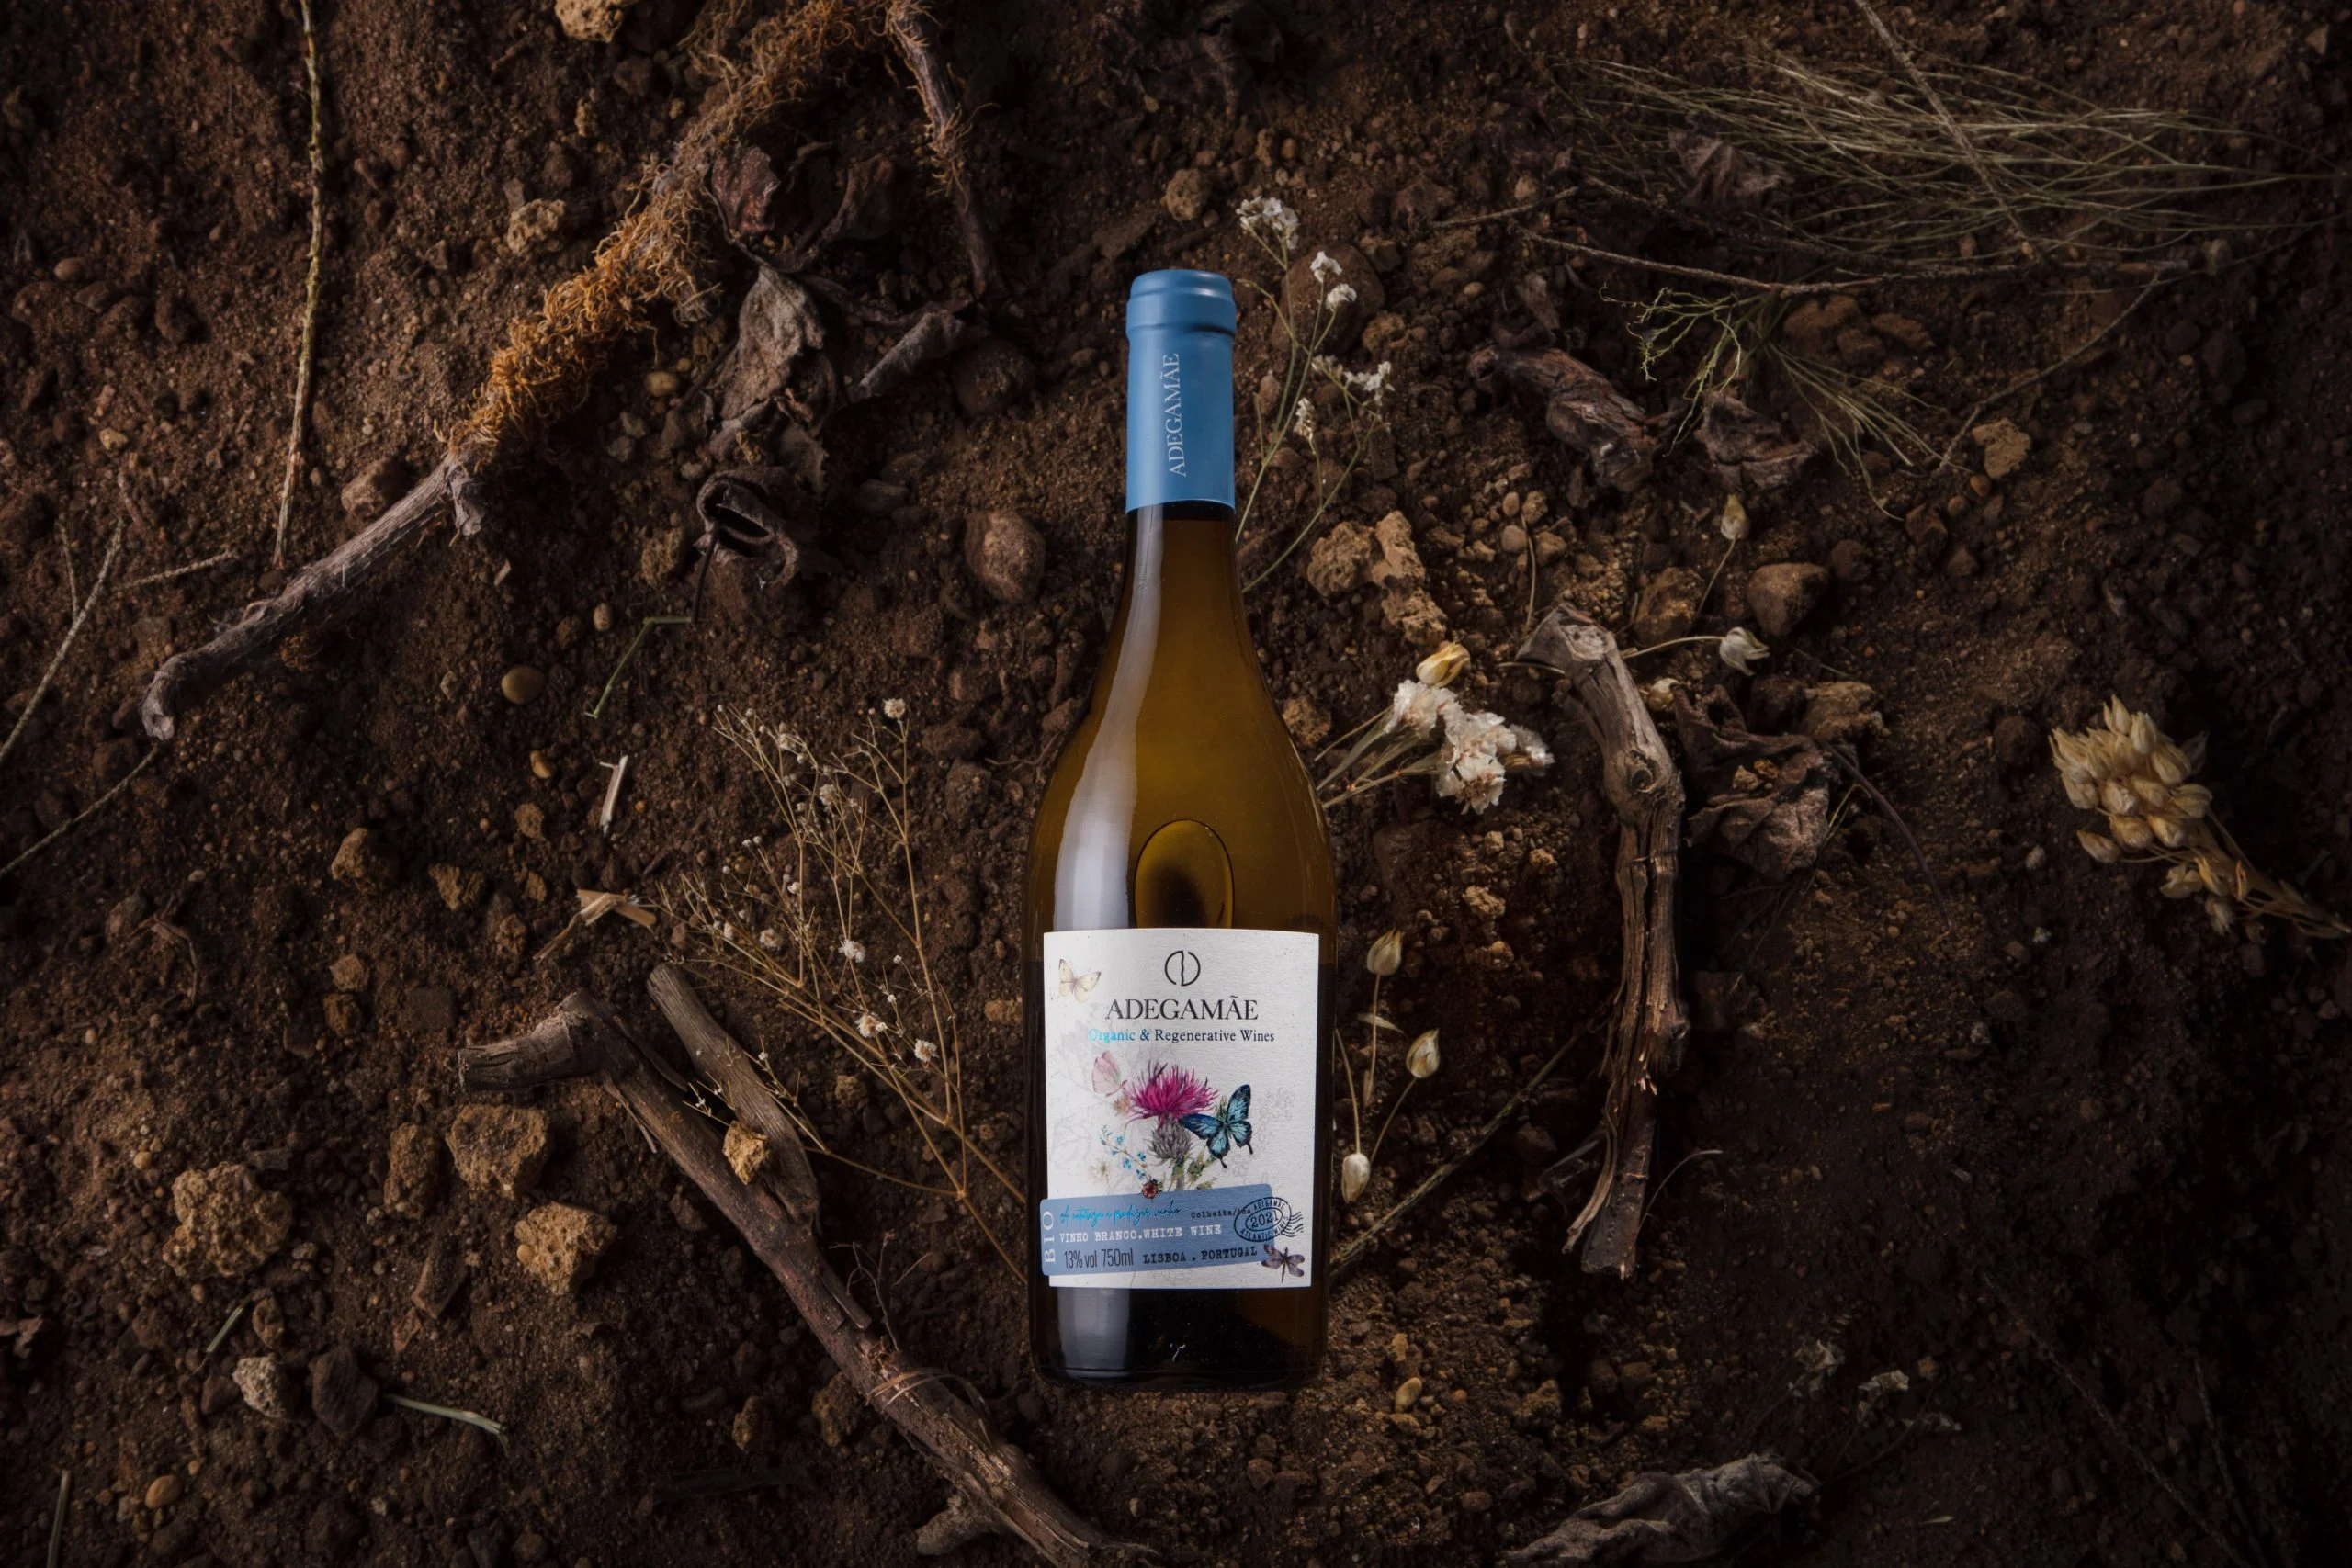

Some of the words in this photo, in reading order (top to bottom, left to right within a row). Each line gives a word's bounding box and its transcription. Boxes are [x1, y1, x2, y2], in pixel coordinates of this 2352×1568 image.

[1159, 353, 1186, 477] ADEGAMÃE
[1105, 995, 1258, 1020] ADEGAMÃE
[1088, 1029, 1136, 1043] Organic
[1139, 1029, 1150, 1042] &
[1155, 1029, 1237, 1043] Regenerative
[1240, 1029, 1274, 1042] Wines
[1250, 1210, 1279, 1228] 2021
[1043, 1211, 1056, 1264] BIO
[1059, 1233, 1089, 1243] VINHO
[1190, 1224, 1222, 1236] WINE
[1239, 1228, 1272, 1240] ATLANTIC
[1064, 1249, 1083, 1269] 13%
[1084, 1250, 1097, 1268] vol
[1101, 1248, 1134, 1267] 750ml
[1142, 1251, 1186, 1264] LISBOA
[1201, 1246, 1258, 1260] PORTUGAL
